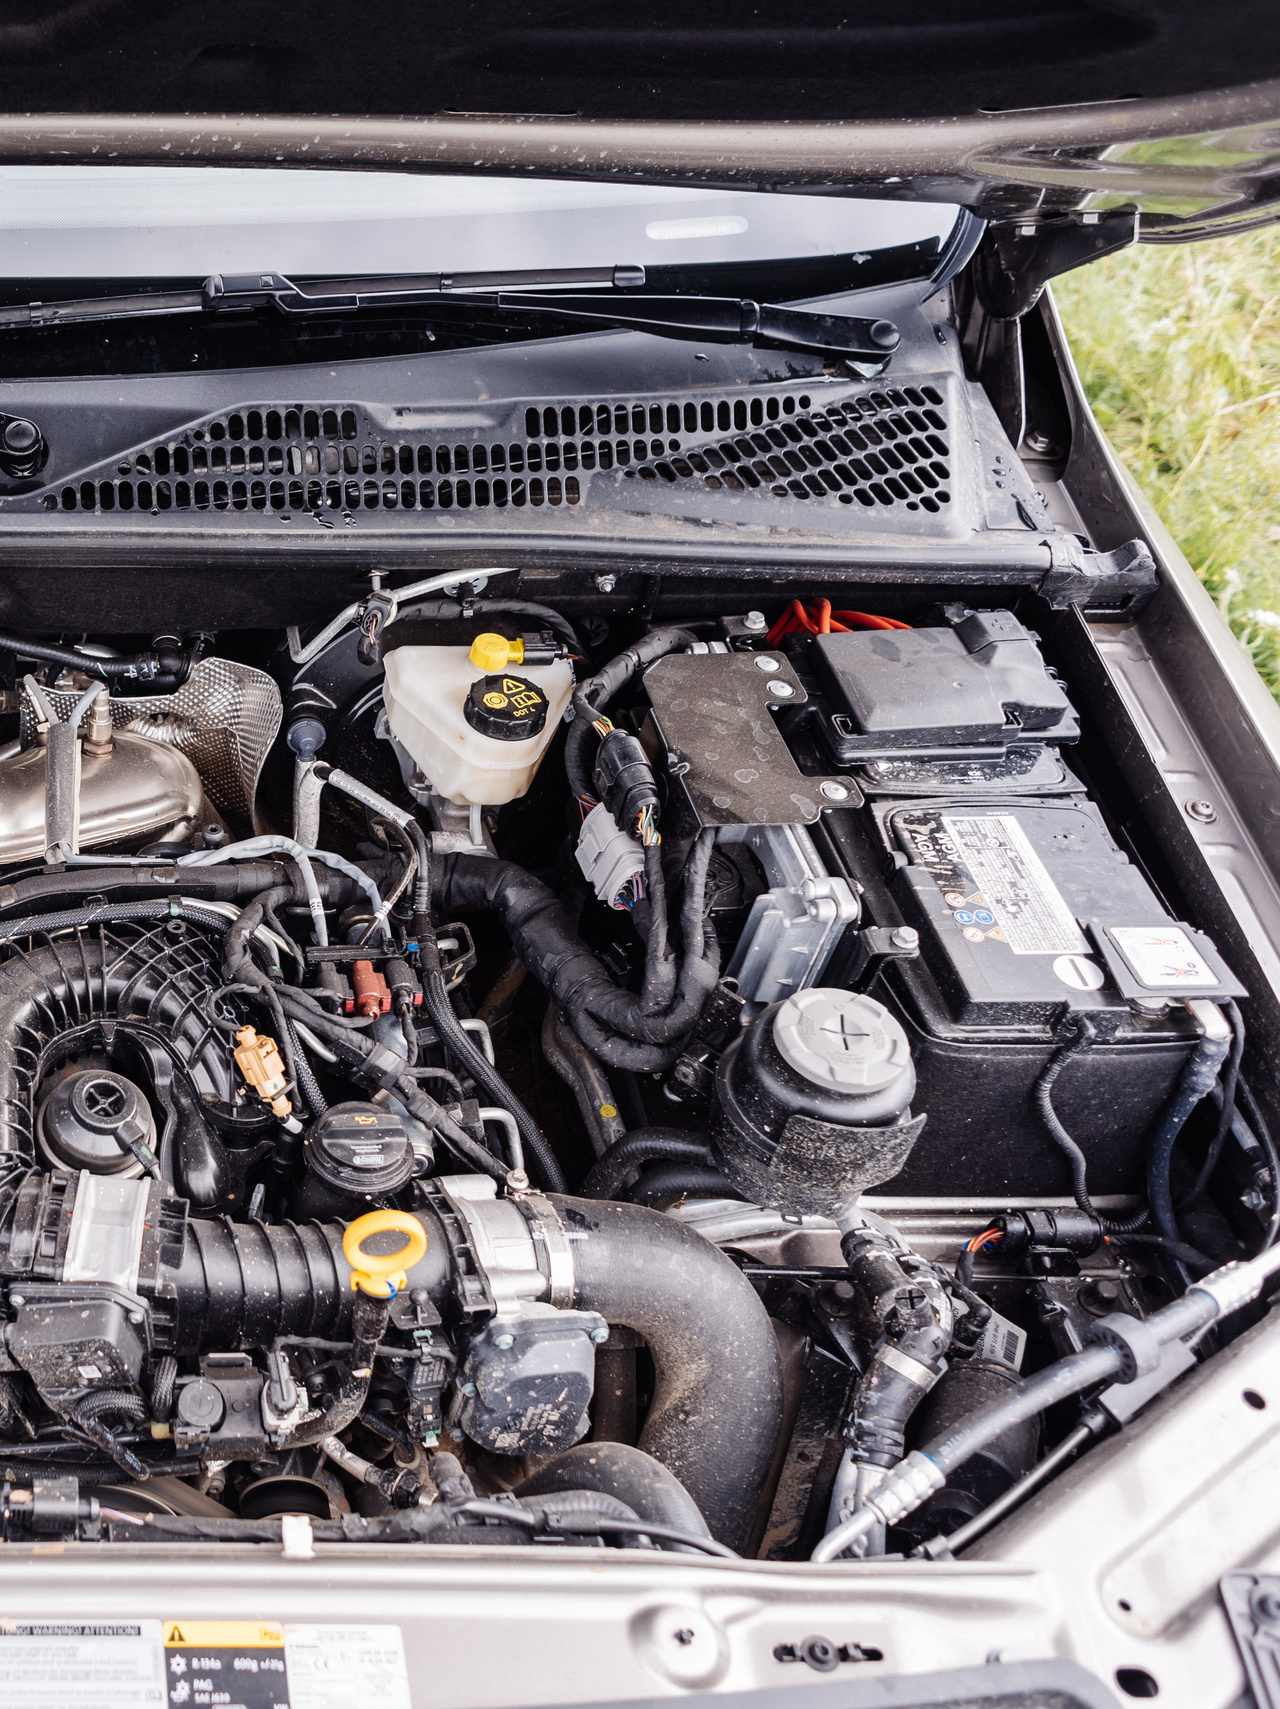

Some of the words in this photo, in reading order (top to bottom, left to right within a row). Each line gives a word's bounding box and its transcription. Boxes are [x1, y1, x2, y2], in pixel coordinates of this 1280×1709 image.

[512, 708, 529, 717] DOT
[910, 832, 939, 863] AGM
[934, 832, 963, 862] AGM
[32, 1626, 82, 1635] WARNING!
[83, 1626, 139, 1635] ATTENTION!
[194, 1678, 214, 1691] PAG
